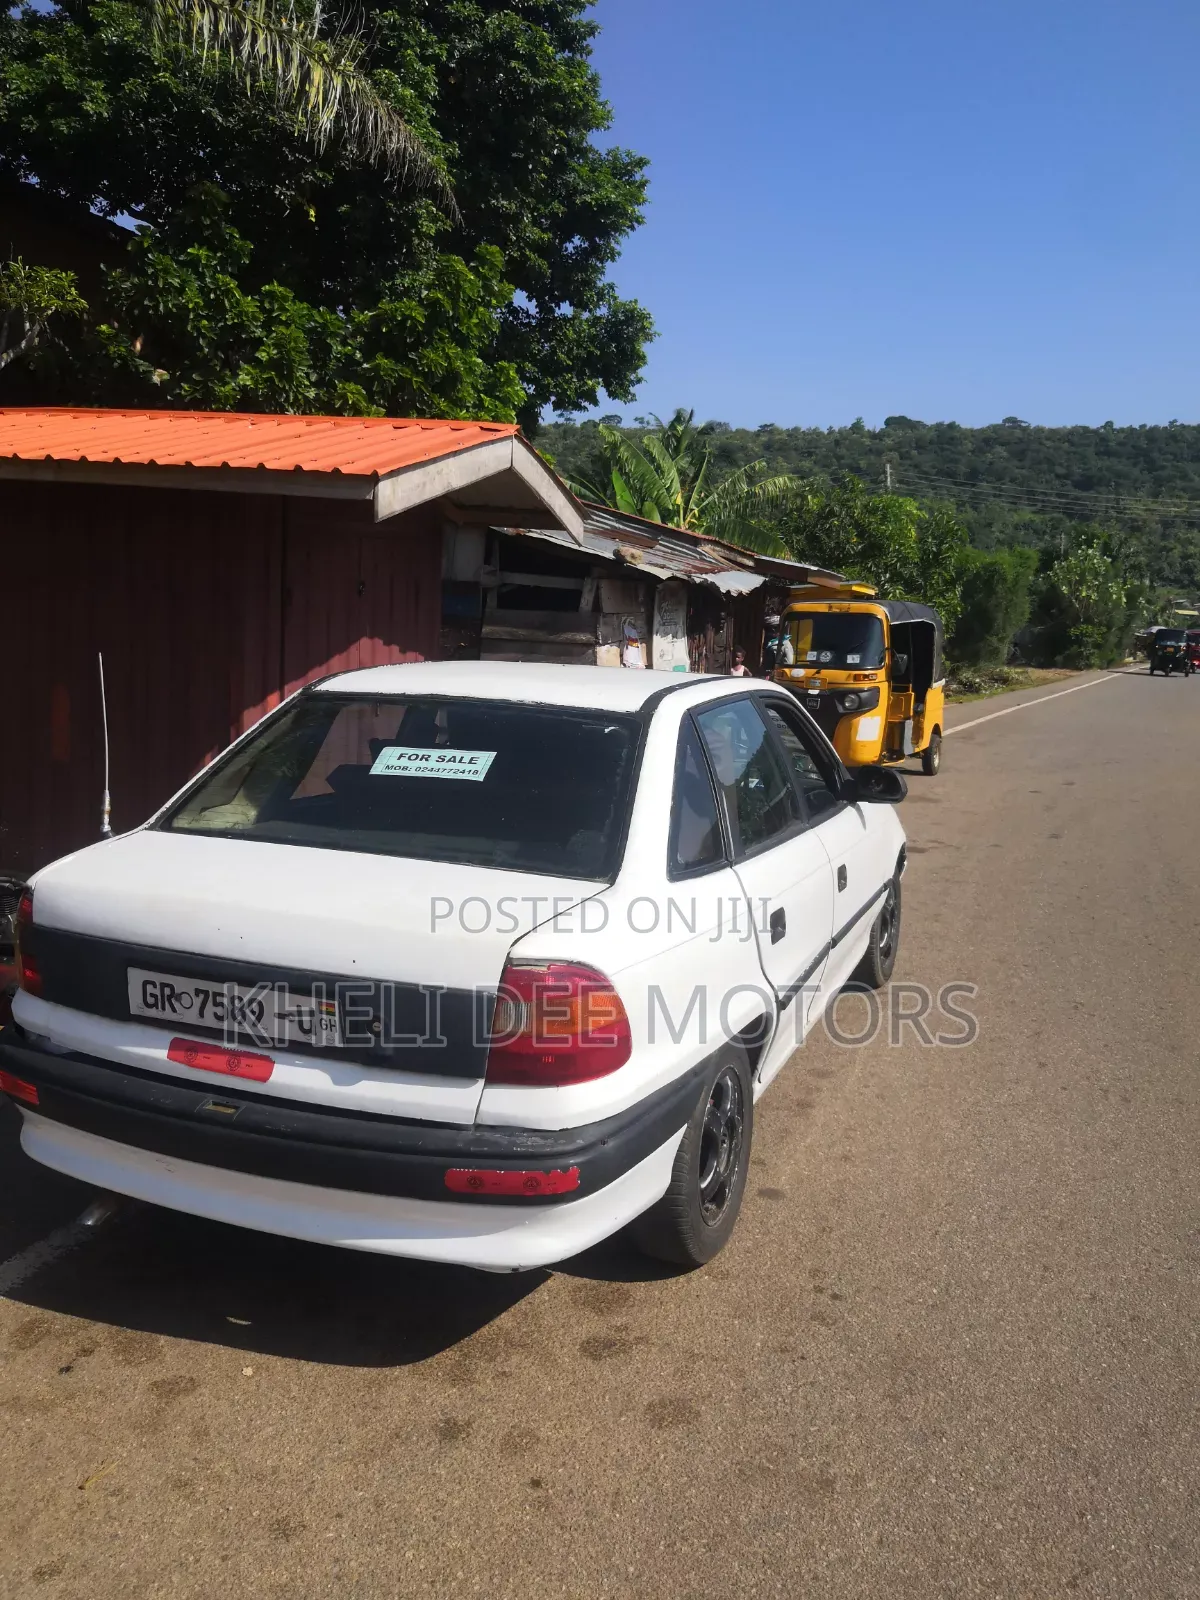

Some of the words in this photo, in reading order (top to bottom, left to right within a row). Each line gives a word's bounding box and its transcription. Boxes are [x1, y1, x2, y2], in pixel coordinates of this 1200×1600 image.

[397, 753, 431, 762] FOR
[435, 754, 480, 765] SALE
[384, 764, 412, 772] MOB:
[415, 766, 479, 775] 0244772418
[142, 979, 177, 1013] GR
[319, 1017, 336, 1033] GH
